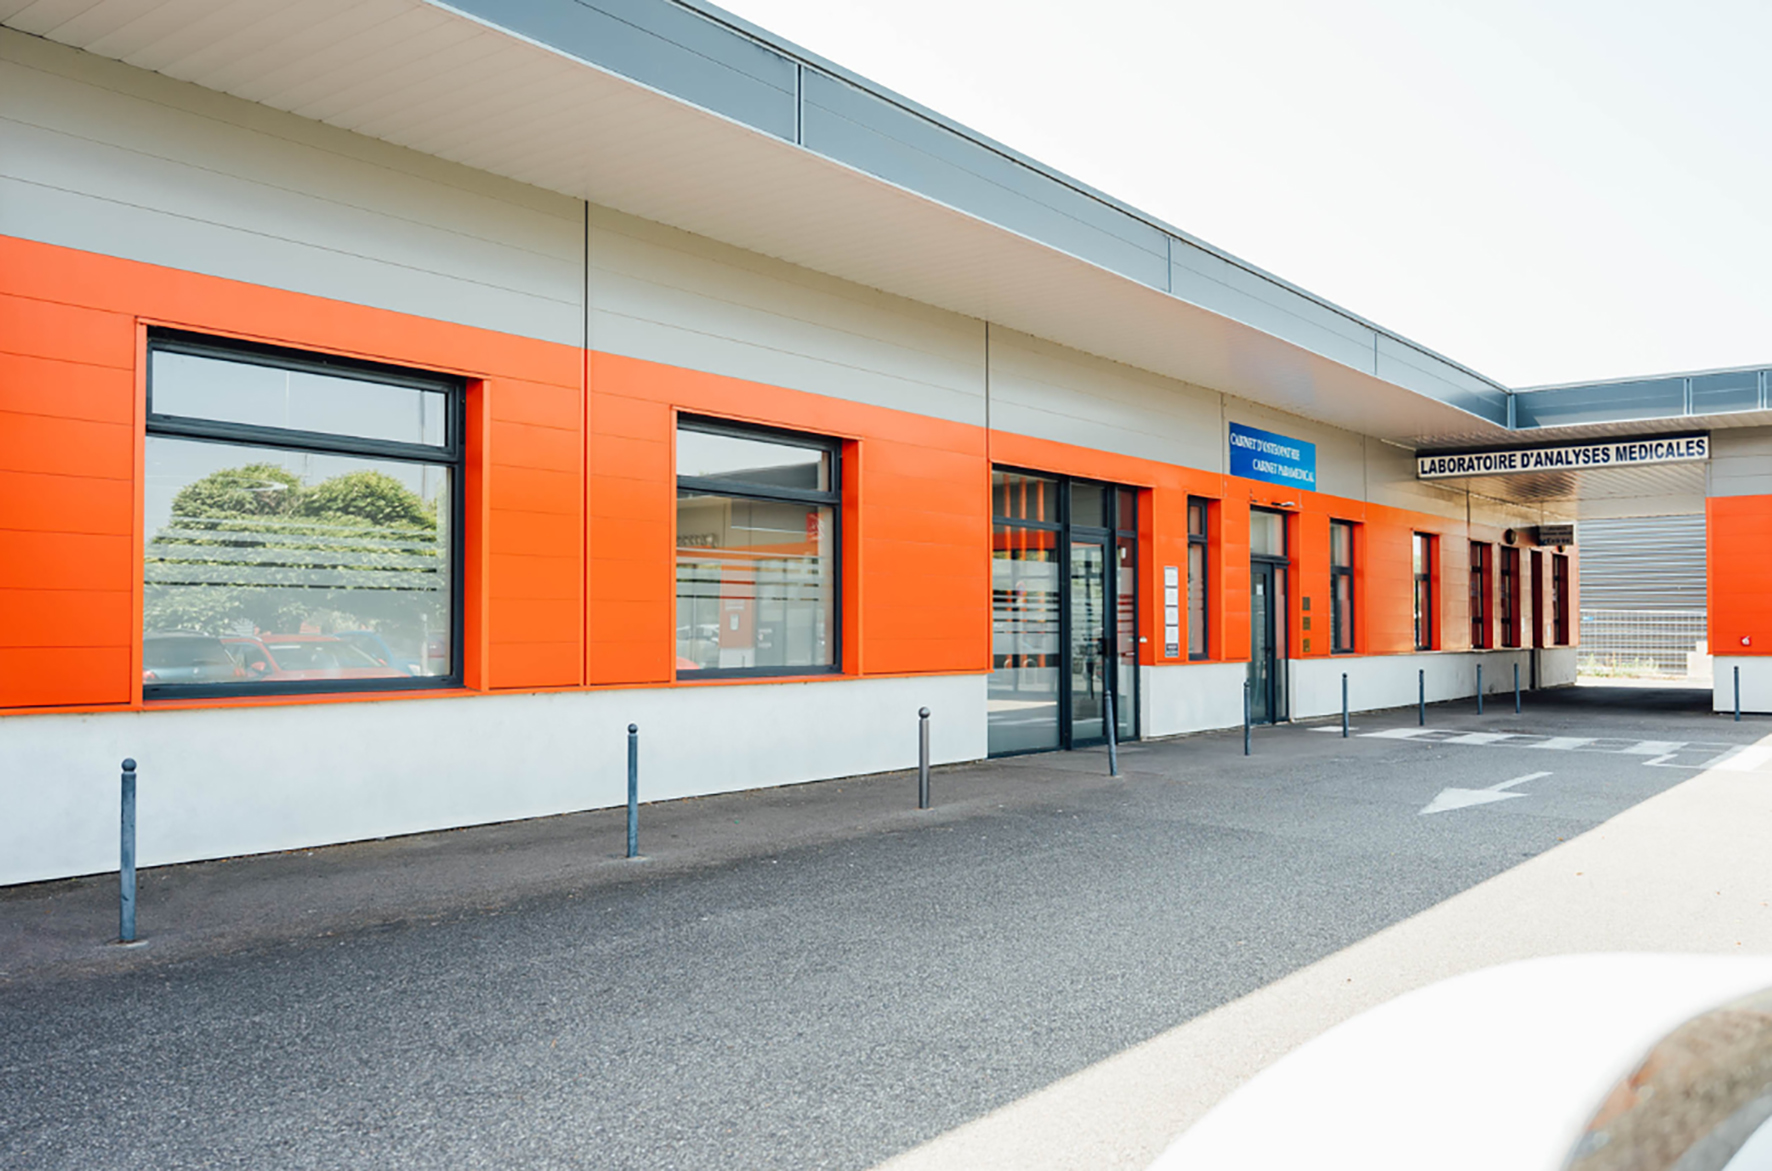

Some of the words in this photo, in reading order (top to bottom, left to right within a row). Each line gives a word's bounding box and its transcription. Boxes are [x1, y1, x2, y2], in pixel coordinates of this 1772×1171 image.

[1420, 453, 1517, 475] LABORATOIRE
[1520, 446, 1611, 469] D'ANALYSES
[1615, 439, 1706, 462] MEDICALES
